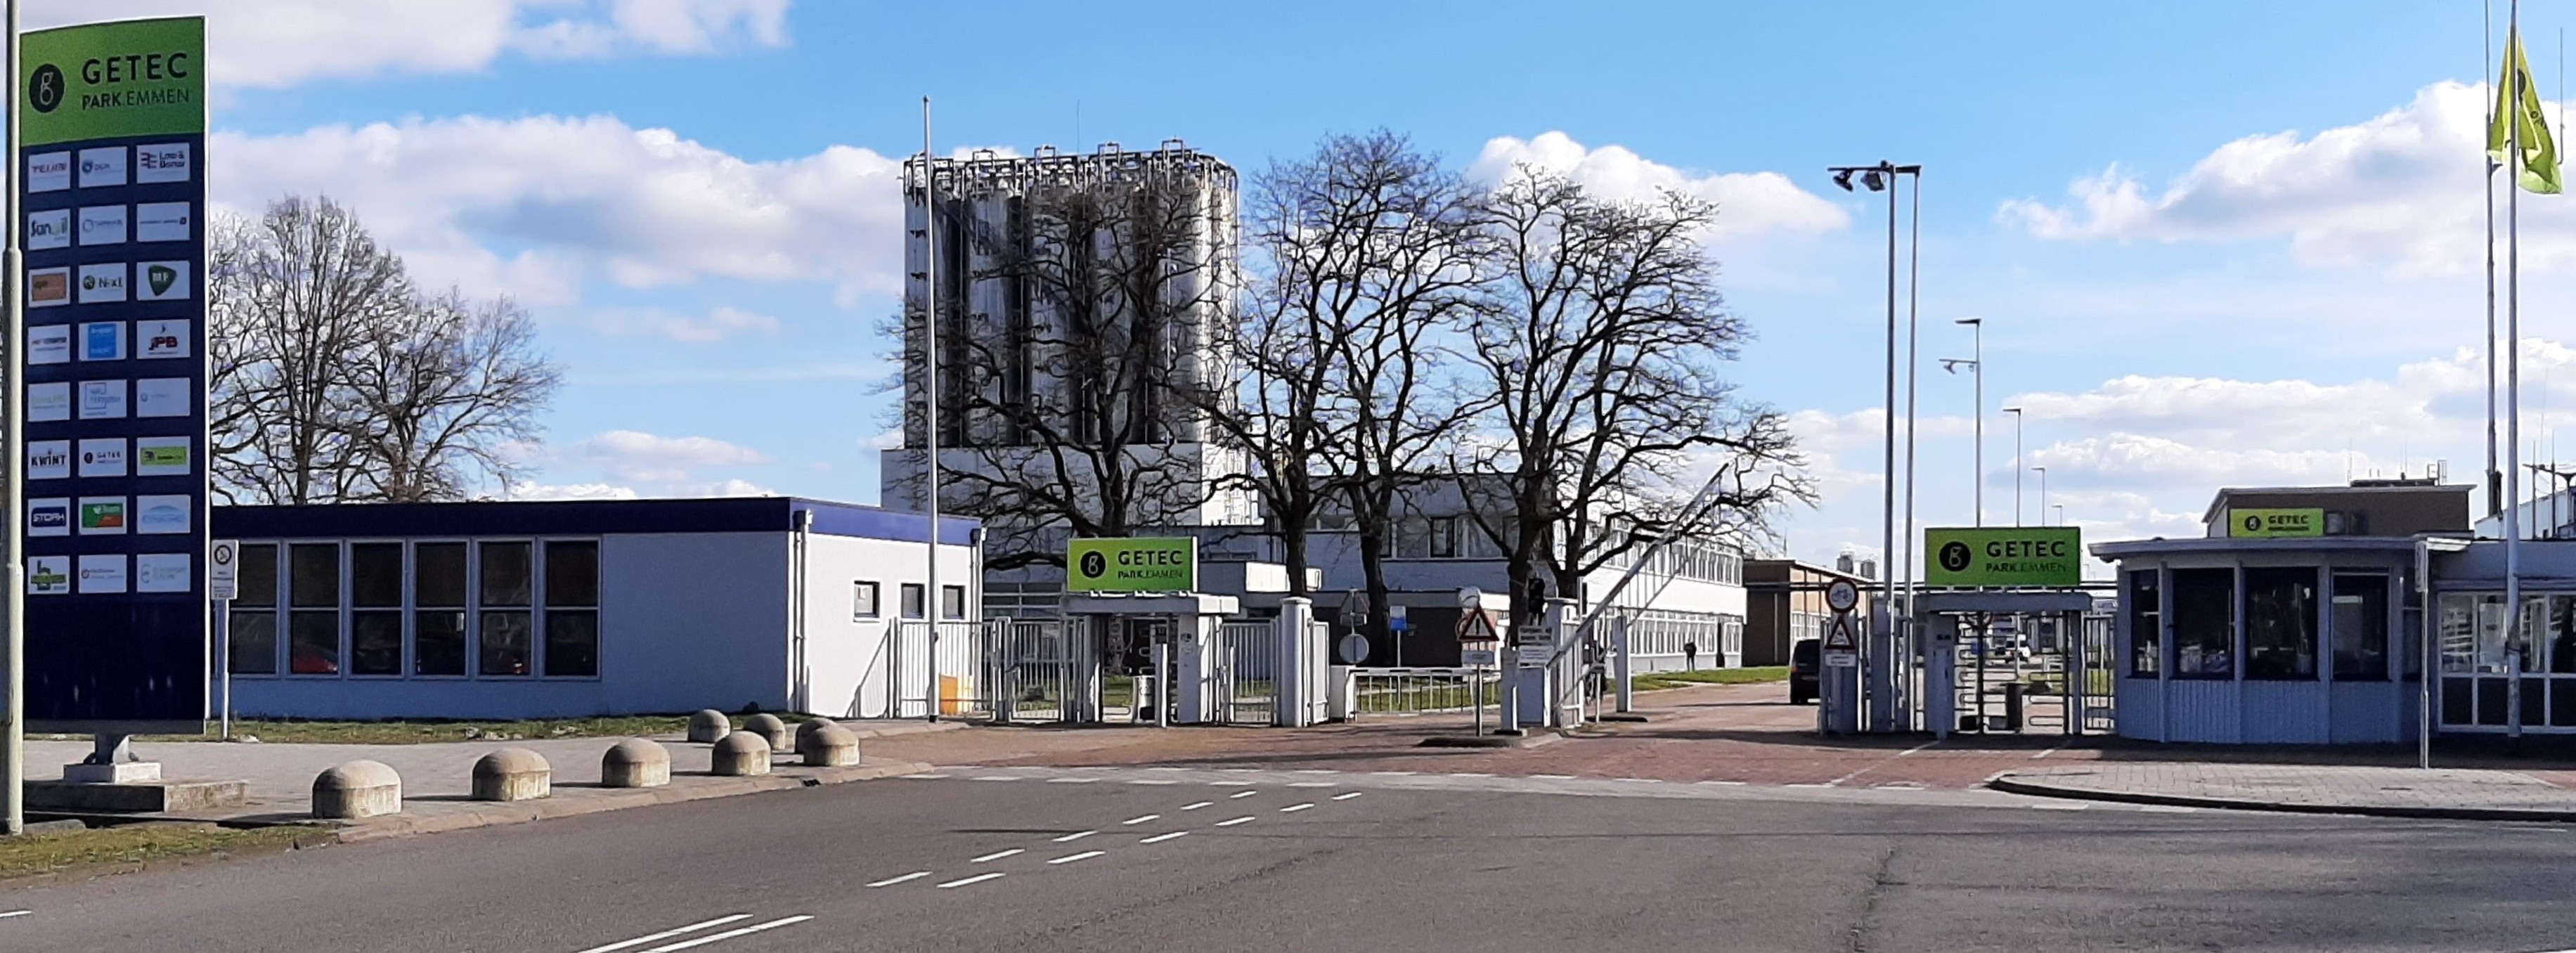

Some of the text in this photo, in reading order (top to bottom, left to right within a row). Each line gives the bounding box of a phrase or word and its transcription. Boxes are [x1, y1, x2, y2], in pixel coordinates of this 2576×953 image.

[82, 53, 188, 85] GETEC
[33, 512, 65, 522] STORK
[2267, 514, 2309, 525] GETEC
[1986, 540, 2066, 557] GETEC
[1118, 550, 1183, 566] GETEC
